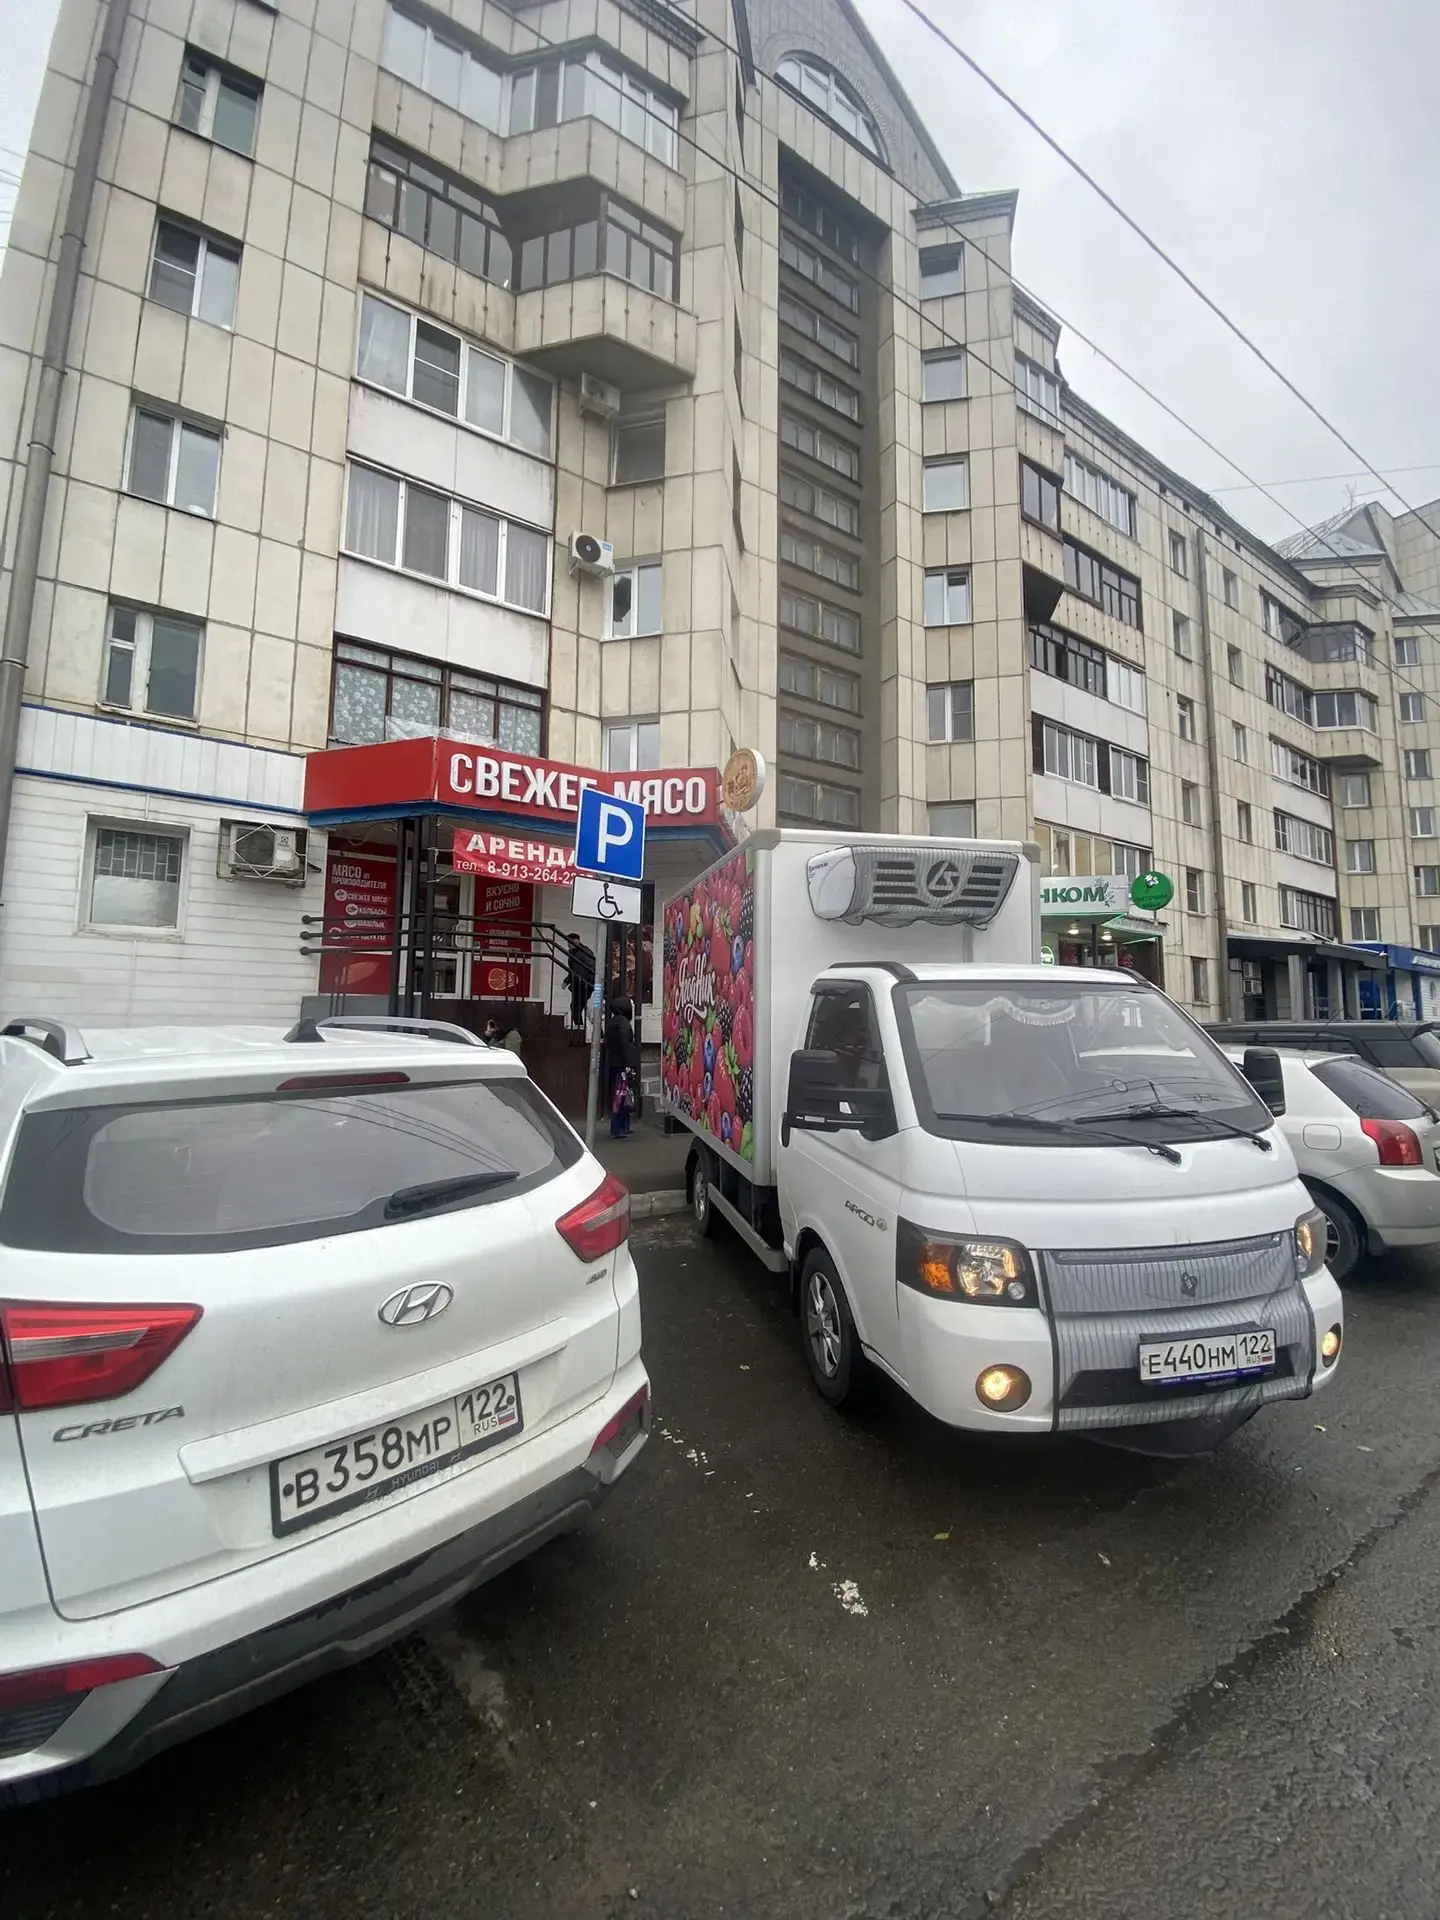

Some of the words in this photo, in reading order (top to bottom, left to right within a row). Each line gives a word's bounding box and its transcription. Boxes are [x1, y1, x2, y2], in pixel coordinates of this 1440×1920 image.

[332, 864, 361, 878] МЯСО
[486, 883, 519, 898] ВКУСНО
[485, 901, 491, 912] И
[493, 896, 520, 911] СОЧНО
[1239, 1334, 1269, 1356] 122
[461, 1383, 508, 1424] 122
[53, 1405, 185, 1442] CRETA
[473, 1417, 498, 1436] RUS
